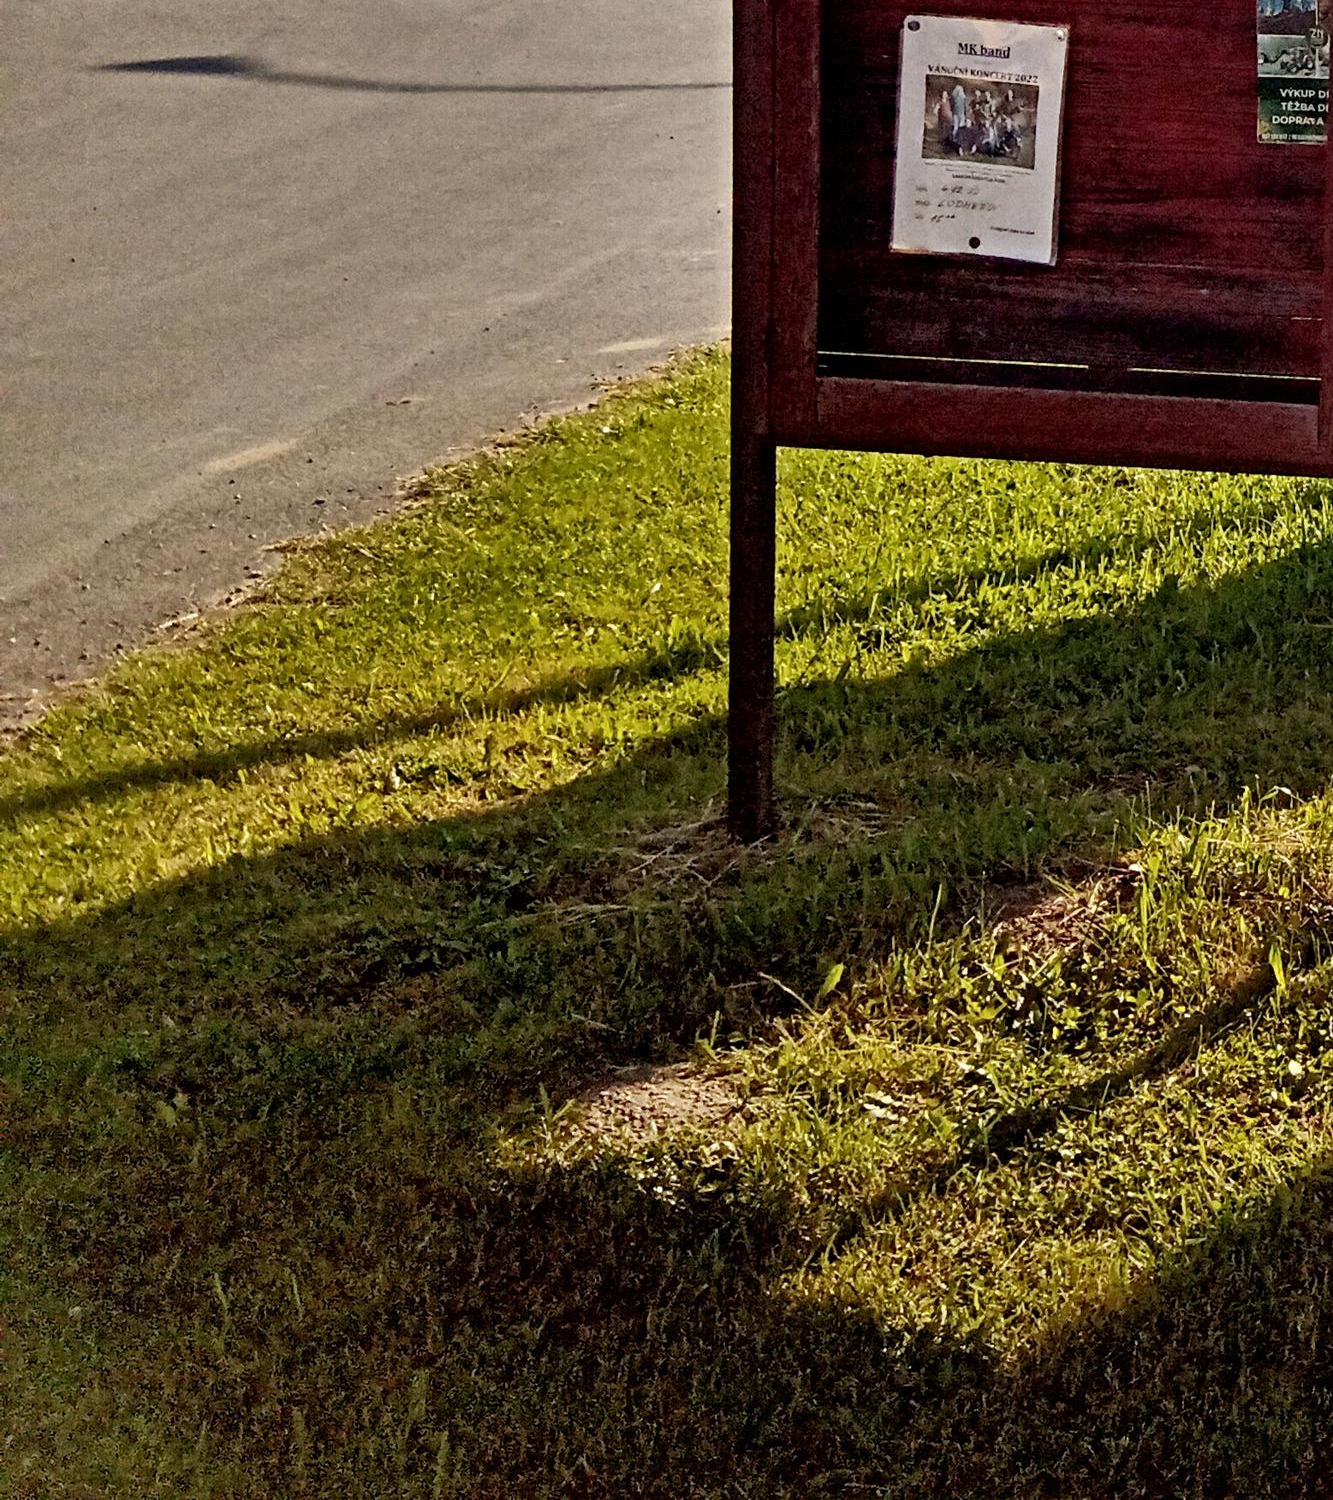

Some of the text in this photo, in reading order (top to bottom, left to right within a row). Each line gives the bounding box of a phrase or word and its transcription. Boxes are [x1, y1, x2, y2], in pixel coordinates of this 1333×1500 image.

[957, 42, 1011, 58] MK band
[1015, 74, 1039, 84] 2022
[1280, 87, 1316, 98] VÝKUP
